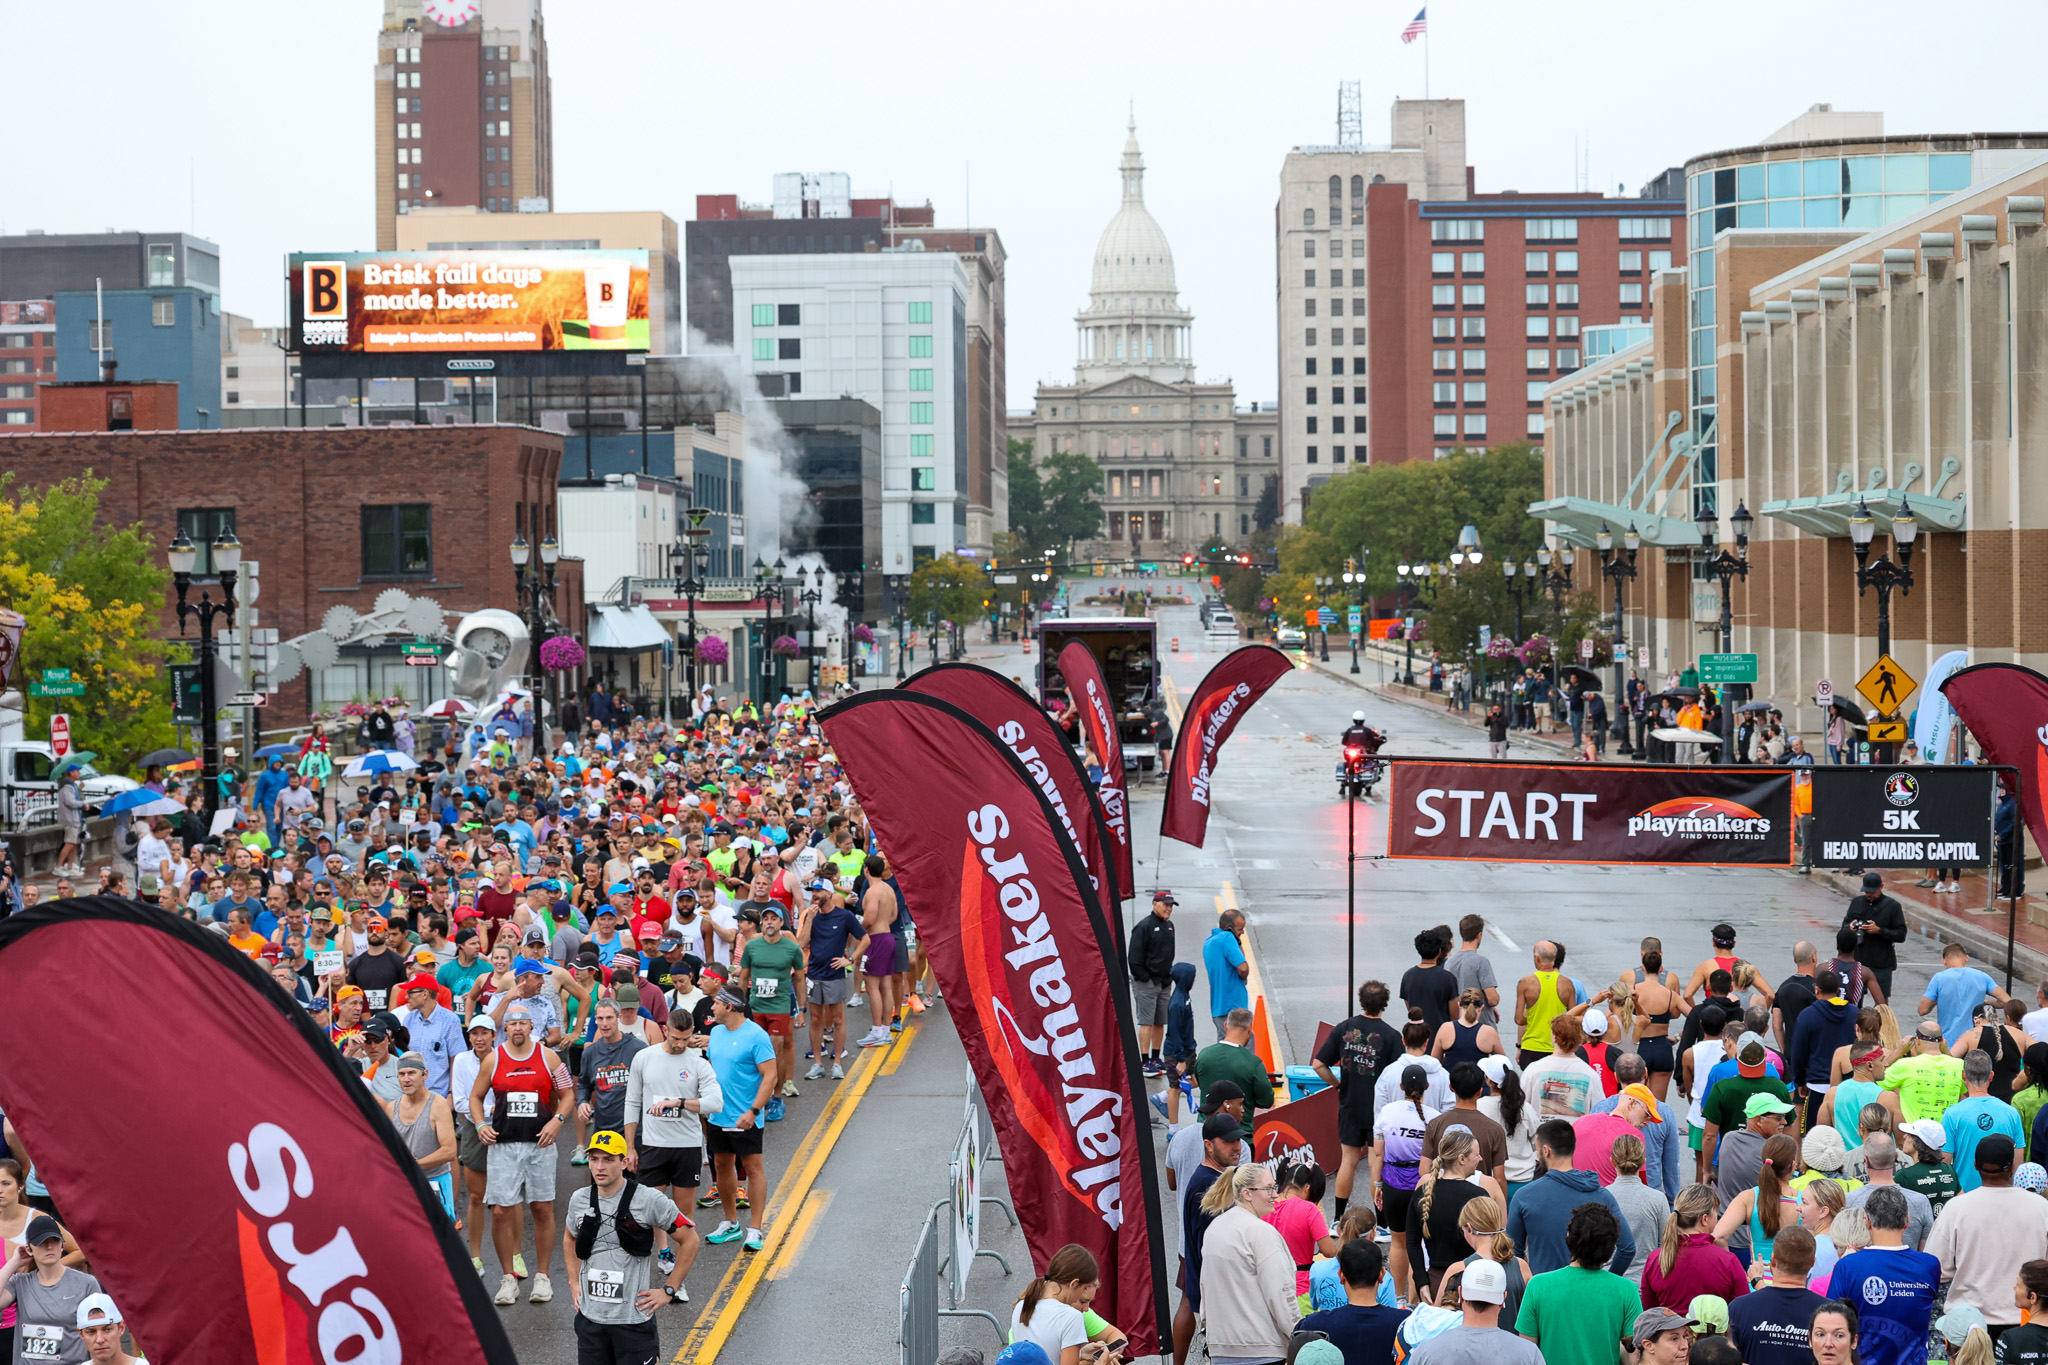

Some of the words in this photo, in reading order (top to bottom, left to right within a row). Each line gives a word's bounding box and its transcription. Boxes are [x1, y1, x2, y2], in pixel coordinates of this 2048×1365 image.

[364, 264, 431, 286] Brisk
[435, 263, 478, 285] fall
[483, 263, 542, 289] days
[312, 268, 338, 312] B
[364, 288, 433, 311] made
[437, 288, 519, 311] better.
[303, 334, 349, 345] COFFEE
[370, 332, 409, 345] Maple
[410, 332, 464, 344] Bourbon
[464, 332, 503, 343] Pecan
[504, 332, 536, 343] Latte
[41, 685, 74, 695] Museum
[174, 671, 182, 709] AUDACIOUS
[1930, 724, 1940, 746] MSU
[1414, 788, 1598, 841] START
[1882, 810, 1921, 830] 5K
[1628, 811, 1771, 837] playmakers
[1823, 841, 1858, 860] HEAD
[1861, 841, 1924, 861] TOWARDS
[1927, 842, 1980, 861] CAPITOL
[757, 986, 776, 995] 1792
[967, 803, 1124, 1232] playmakers
[1344, 1042, 1368, 1052] Jesus
[1354, 1055, 1375, 1068] King
[595, 1069, 630, 1079] ATLANTA
[510, 1102, 535, 1114] 1329
[595, 1134, 612, 1145] M
[590, 1281, 619, 1298] 1897
[1769, 1332, 1808, 1342] INSURANCE
[25, 1338, 58, 1355] 1823
